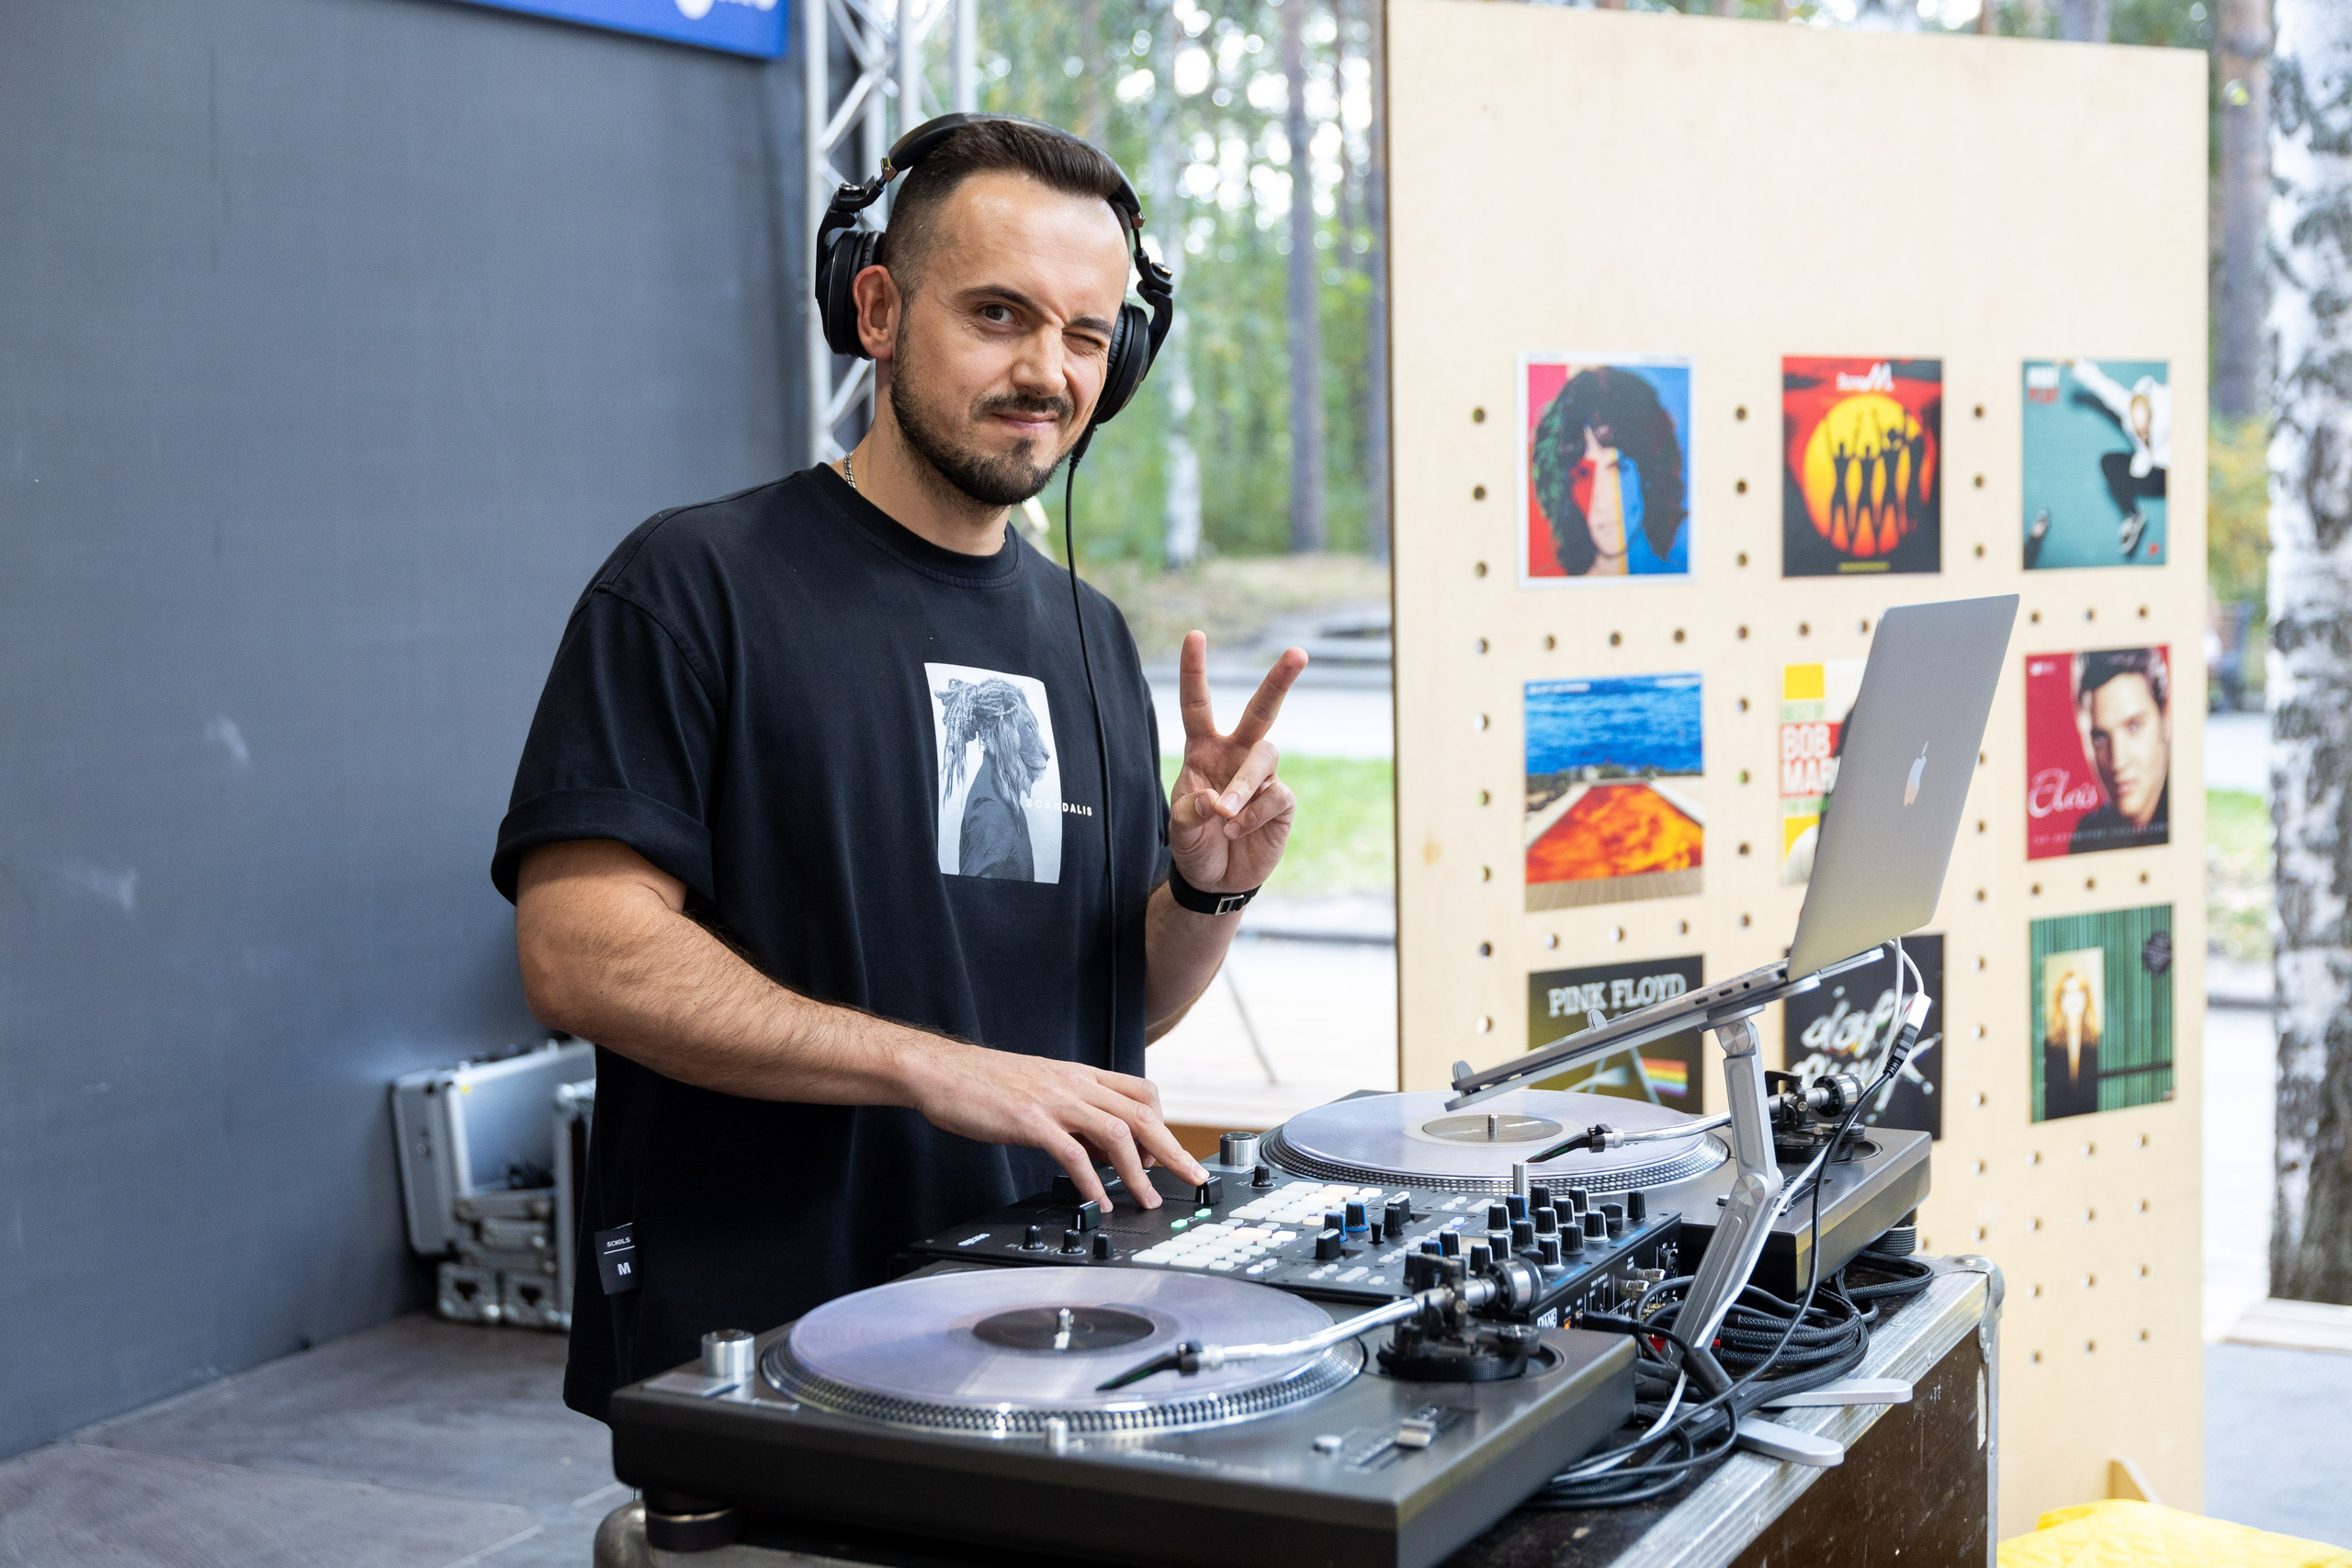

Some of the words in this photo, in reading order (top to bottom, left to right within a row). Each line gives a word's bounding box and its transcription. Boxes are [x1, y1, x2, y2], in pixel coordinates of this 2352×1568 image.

[1783, 724, 1831, 759] BOB
[1025, 798, 1093, 817] SCANDALIS
[1547, 981, 1608, 1018] PINK
[1610, 973, 1687, 1010] FLOYD
[617, 1261, 632, 1276] M
